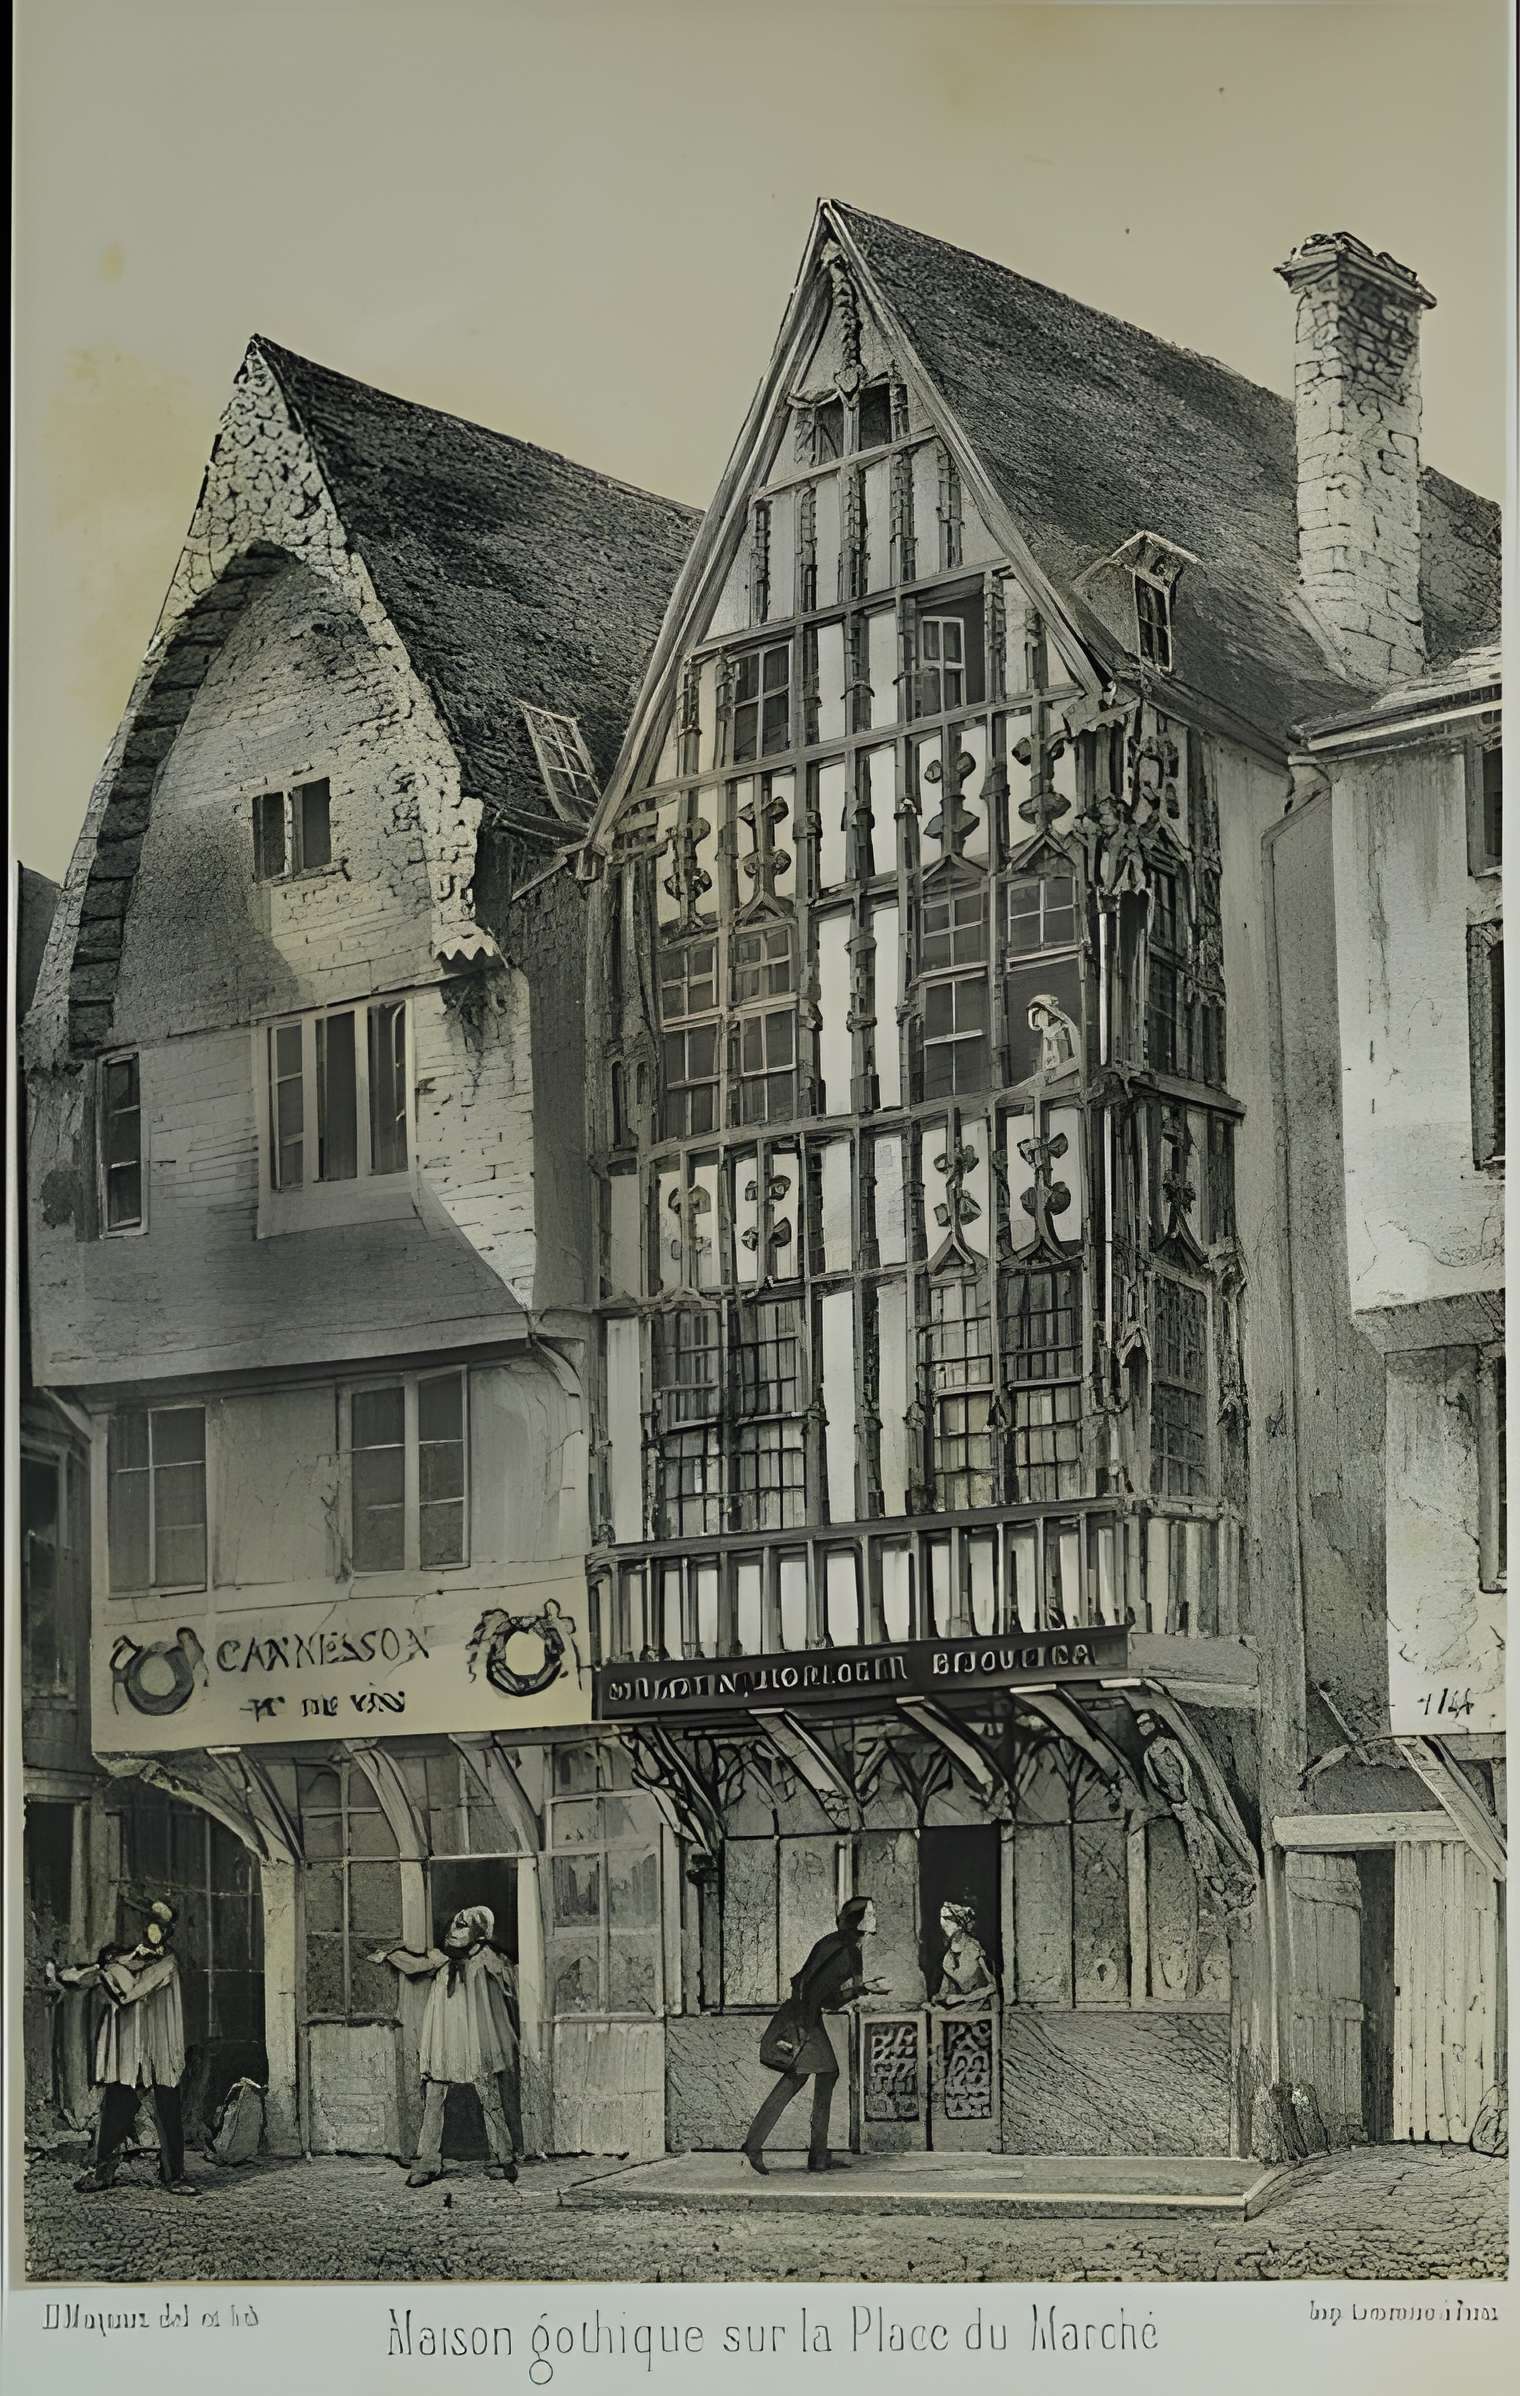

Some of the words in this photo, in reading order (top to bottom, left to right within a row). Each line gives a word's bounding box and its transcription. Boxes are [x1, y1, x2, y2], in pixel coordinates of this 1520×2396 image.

[388, 2308, 512, 2356] Maison
[723, 2324, 786, 2352] sur
[801, 2307, 832, 2353] la
[849, 2305, 950, 2352] Place
[965, 2307, 1007, 2351] du
[1031, 2304, 1159, 2351] Marché
